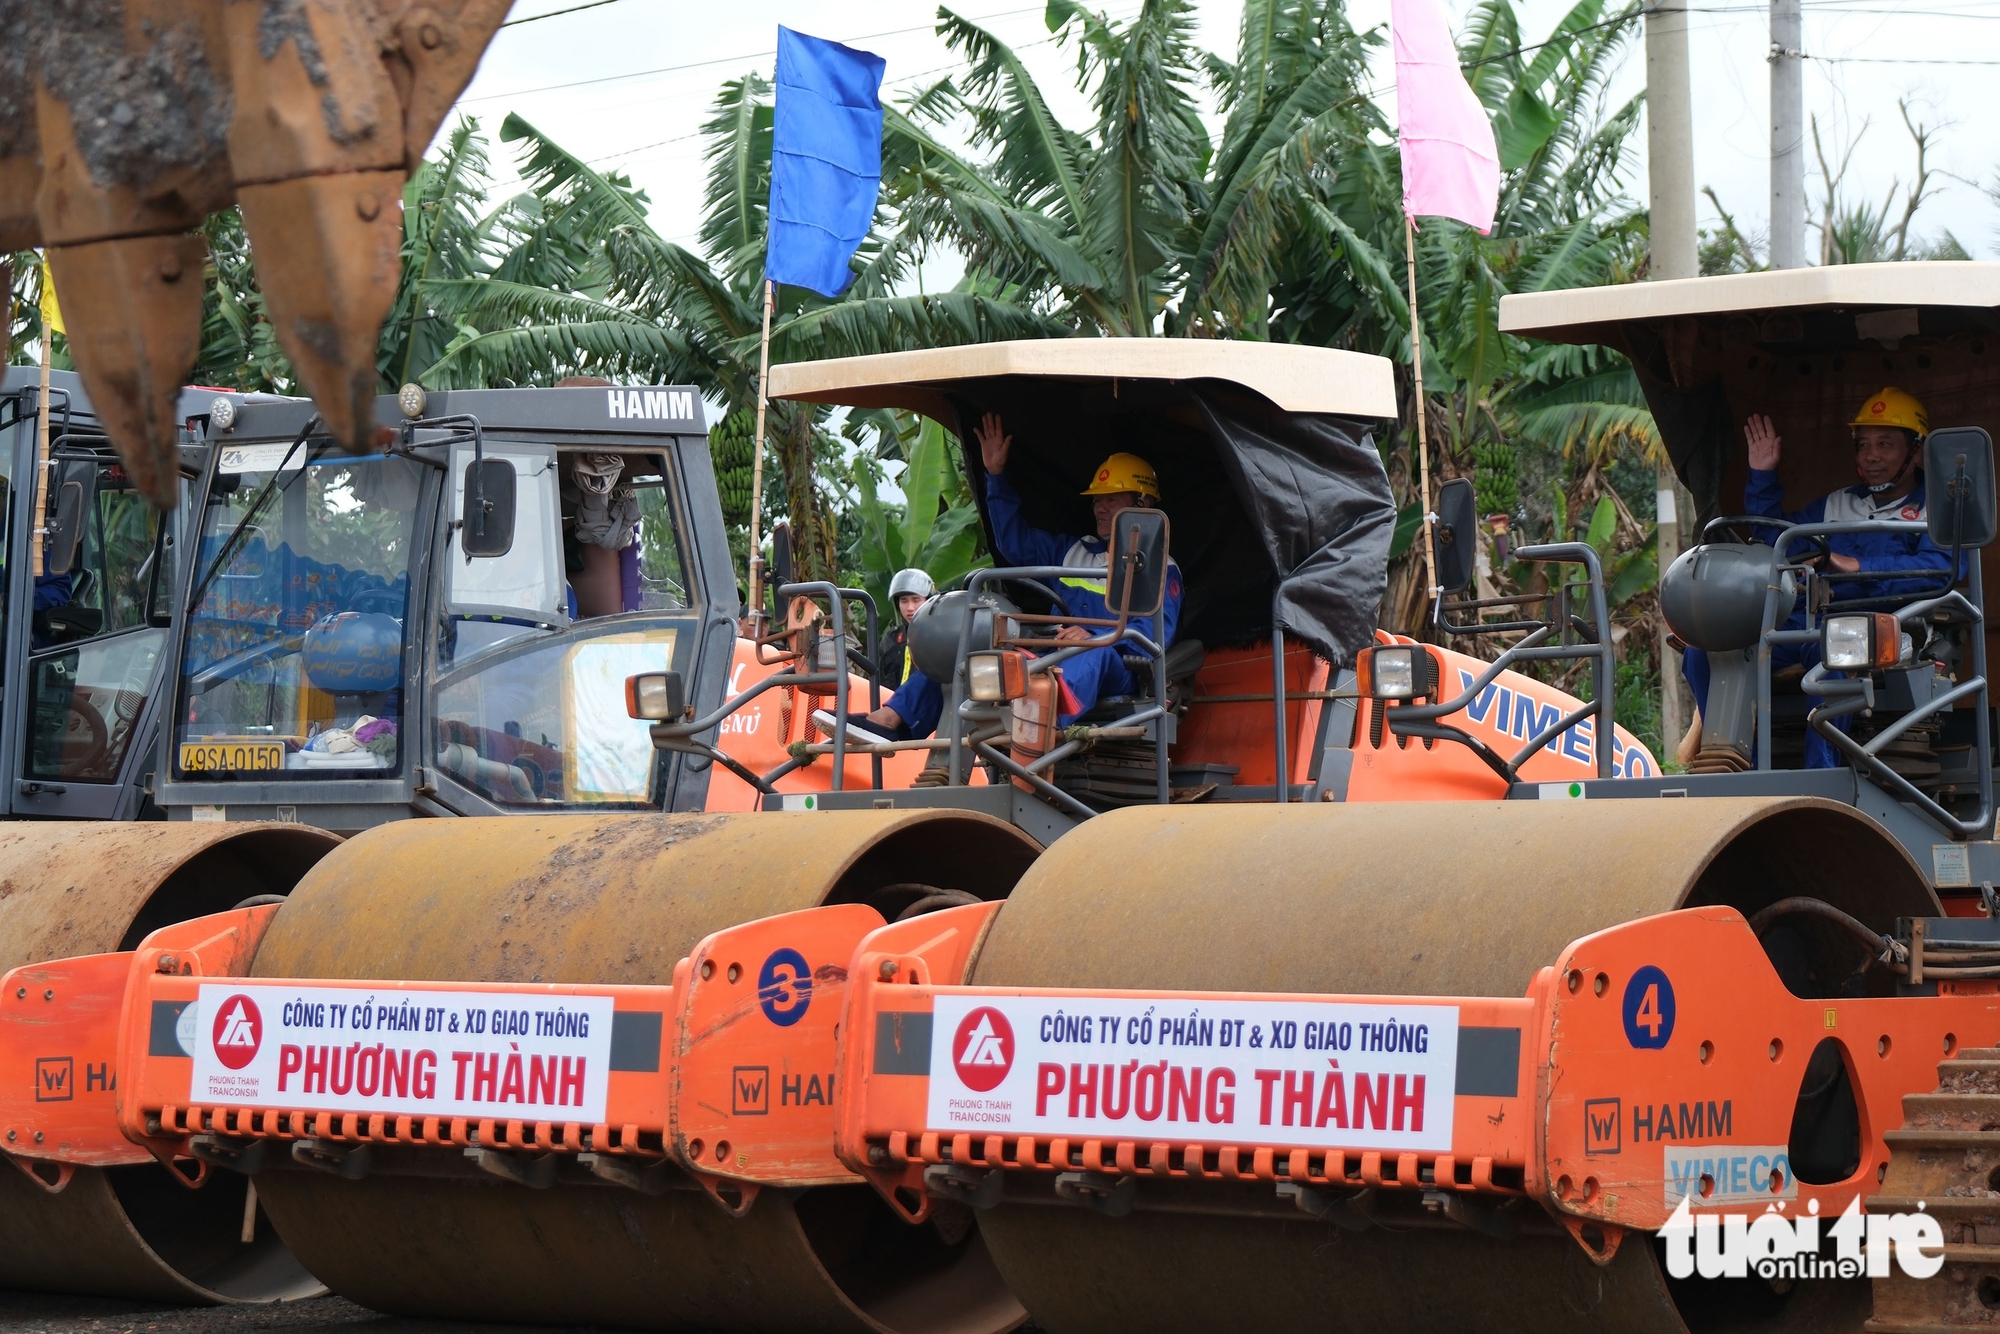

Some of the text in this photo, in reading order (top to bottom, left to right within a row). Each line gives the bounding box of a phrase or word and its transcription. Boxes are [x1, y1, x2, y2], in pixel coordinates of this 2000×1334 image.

[607, 390, 694, 419] HAMM
[773, 963, 798, 1013] 3
[283, 995, 590, 1038] CÔNG TY CỔ PHẦN ĐT & XD GIAO THÔNG
[1040, 1005, 1429, 1053] CÔNG TY CỔ PHẦN ĐT & XD GIAO THÔNG
[1636, 983, 1662, 1038] 4
[208, 1086, 258, 1097] TRANCONSIN
[209, 1075, 259, 1086] PHUONG THANH
[277, 1041, 587, 1107] PHƯƠNG THÀNH
[1035, 1058, 1426, 1132] PHƯƠNG THÀNH
[949, 1098, 1012, 1110] PHUONG THANH
[949, 1111, 1011, 1123] TRANCONSIN
[1633, 1099, 1732, 1143] HAMM
[1670, 1153, 1792, 1197] VIMECO
